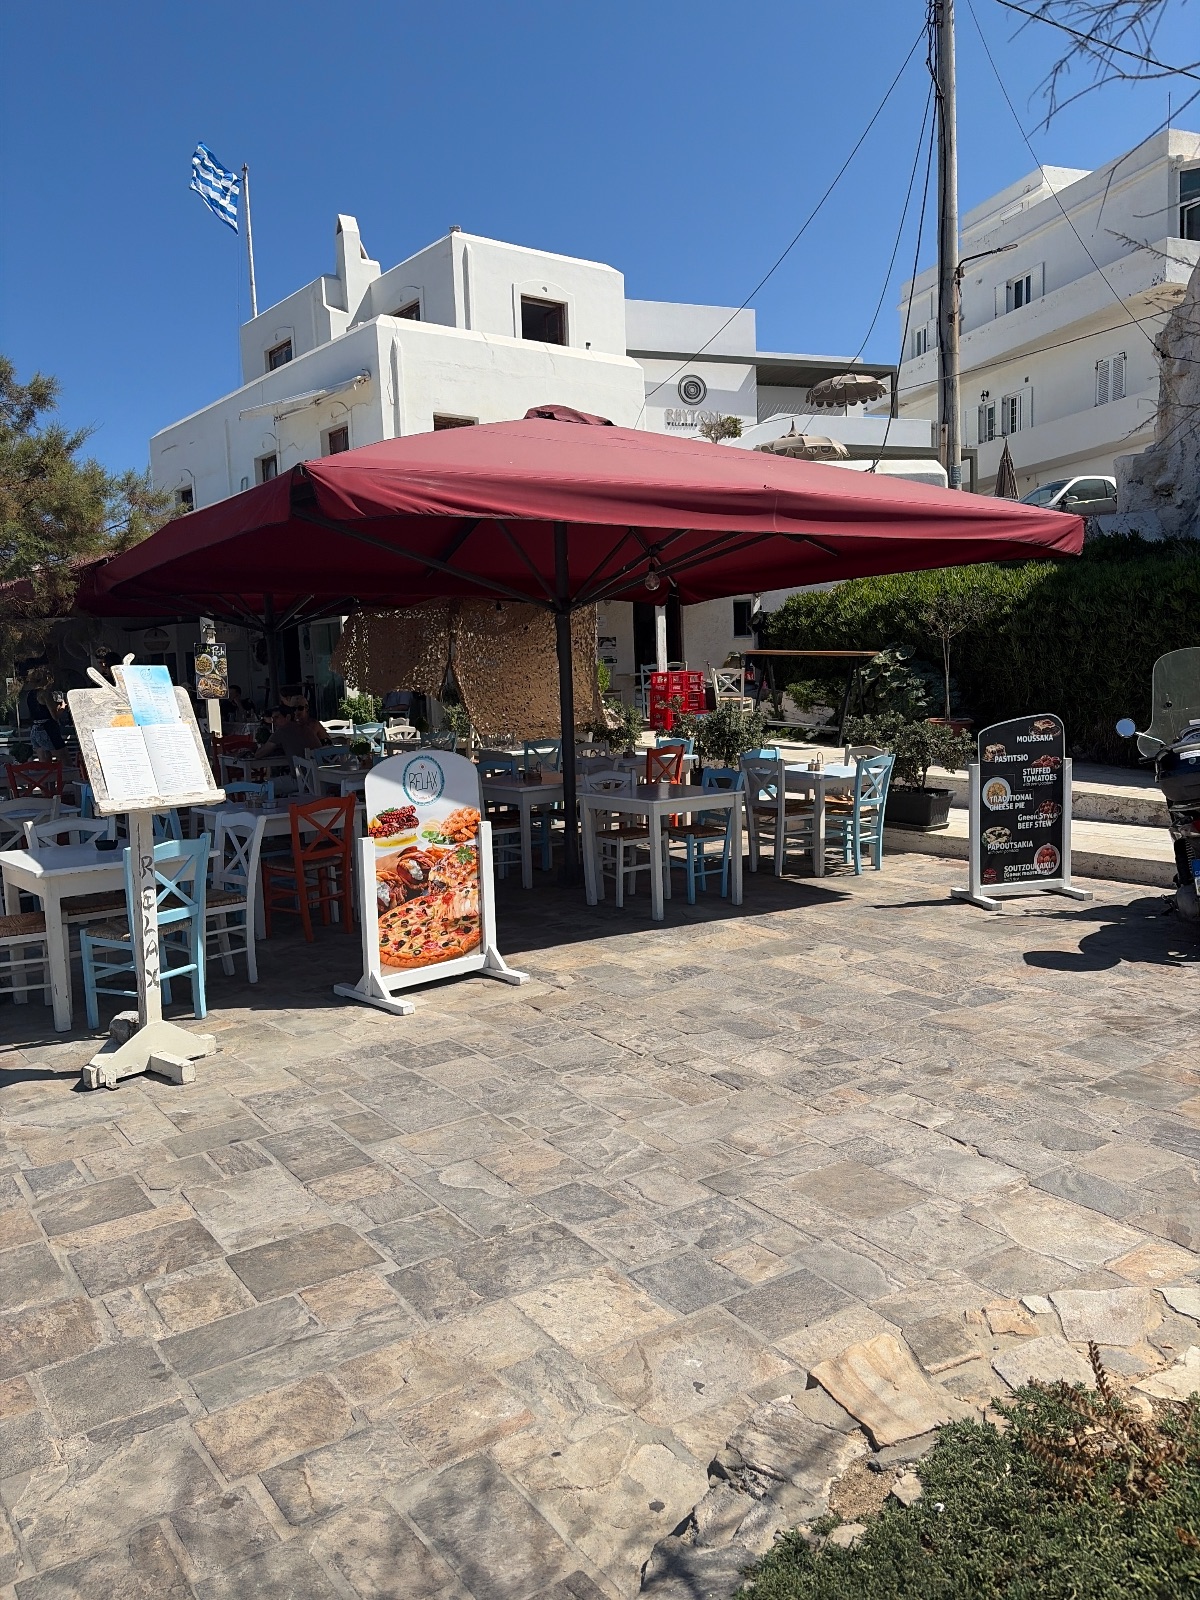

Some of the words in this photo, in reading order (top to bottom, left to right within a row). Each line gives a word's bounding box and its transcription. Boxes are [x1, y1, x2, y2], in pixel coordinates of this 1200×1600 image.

[1016, 734, 1054, 743] MOUSSAKA
[994, 754, 1029, 763] PASTITSIO
[1022, 767, 1051, 775] STUFFED
[409, 771, 438, 791] RELAX
[1022, 774, 1057, 783] TOMATOES
[990, 793, 1033, 802] TRADITIONAL
[989, 802, 1014, 811] CHEESE
[1014, 801, 1026, 810] PIE
[1017, 821, 1034, 829] BEEF
[1034, 820, 1052, 828] STEW
[987, 840, 1034, 851] PAPOUTSAKIA
[141, 855, 160, 989] RELAX
